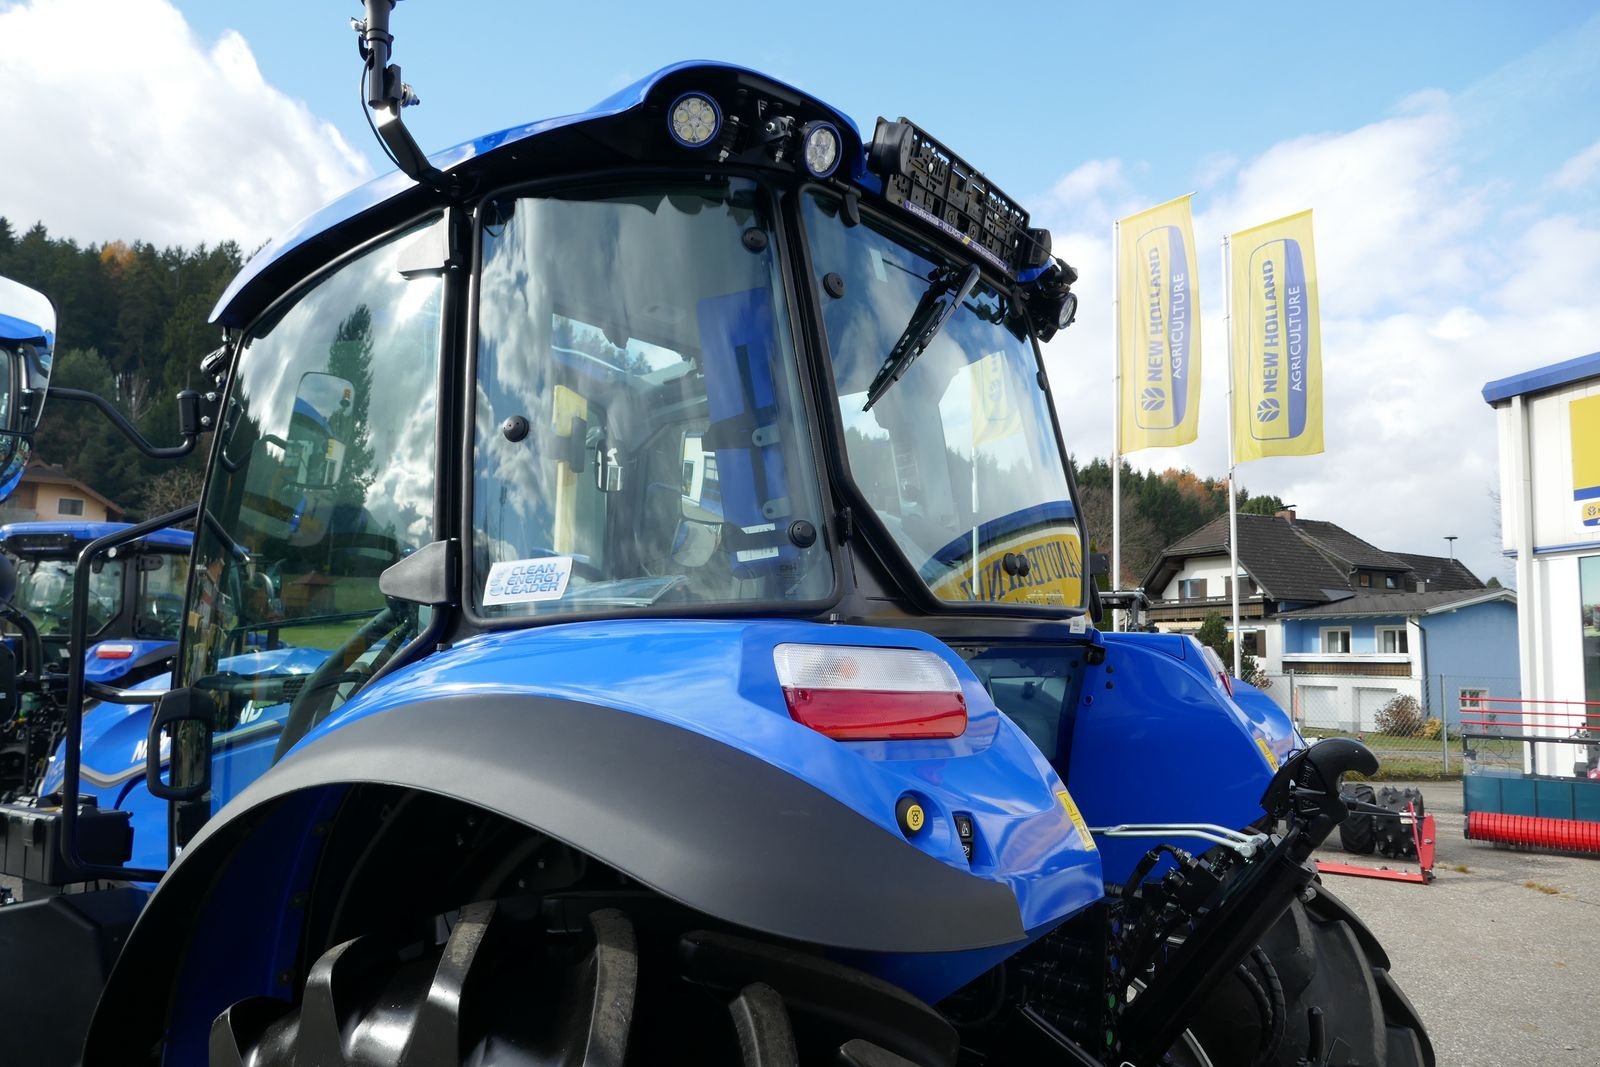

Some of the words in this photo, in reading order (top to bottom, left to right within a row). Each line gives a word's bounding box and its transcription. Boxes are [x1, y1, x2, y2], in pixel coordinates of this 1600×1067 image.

[1149, 247, 1162, 335] HOLLAND
[1263, 260, 1279, 347] HOLLAND
[1171, 273, 1185, 379] AGRICULTURE
[1288, 286, 1302, 392] AGRICULTURE
[1147, 340, 1163, 381] NEW
[1263, 352, 1278, 393] NEW
[504, 582, 560, 595] LEADER
[507, 572, 565, 585] ENERGY
[511, 563, 557, 576] CLEAN
